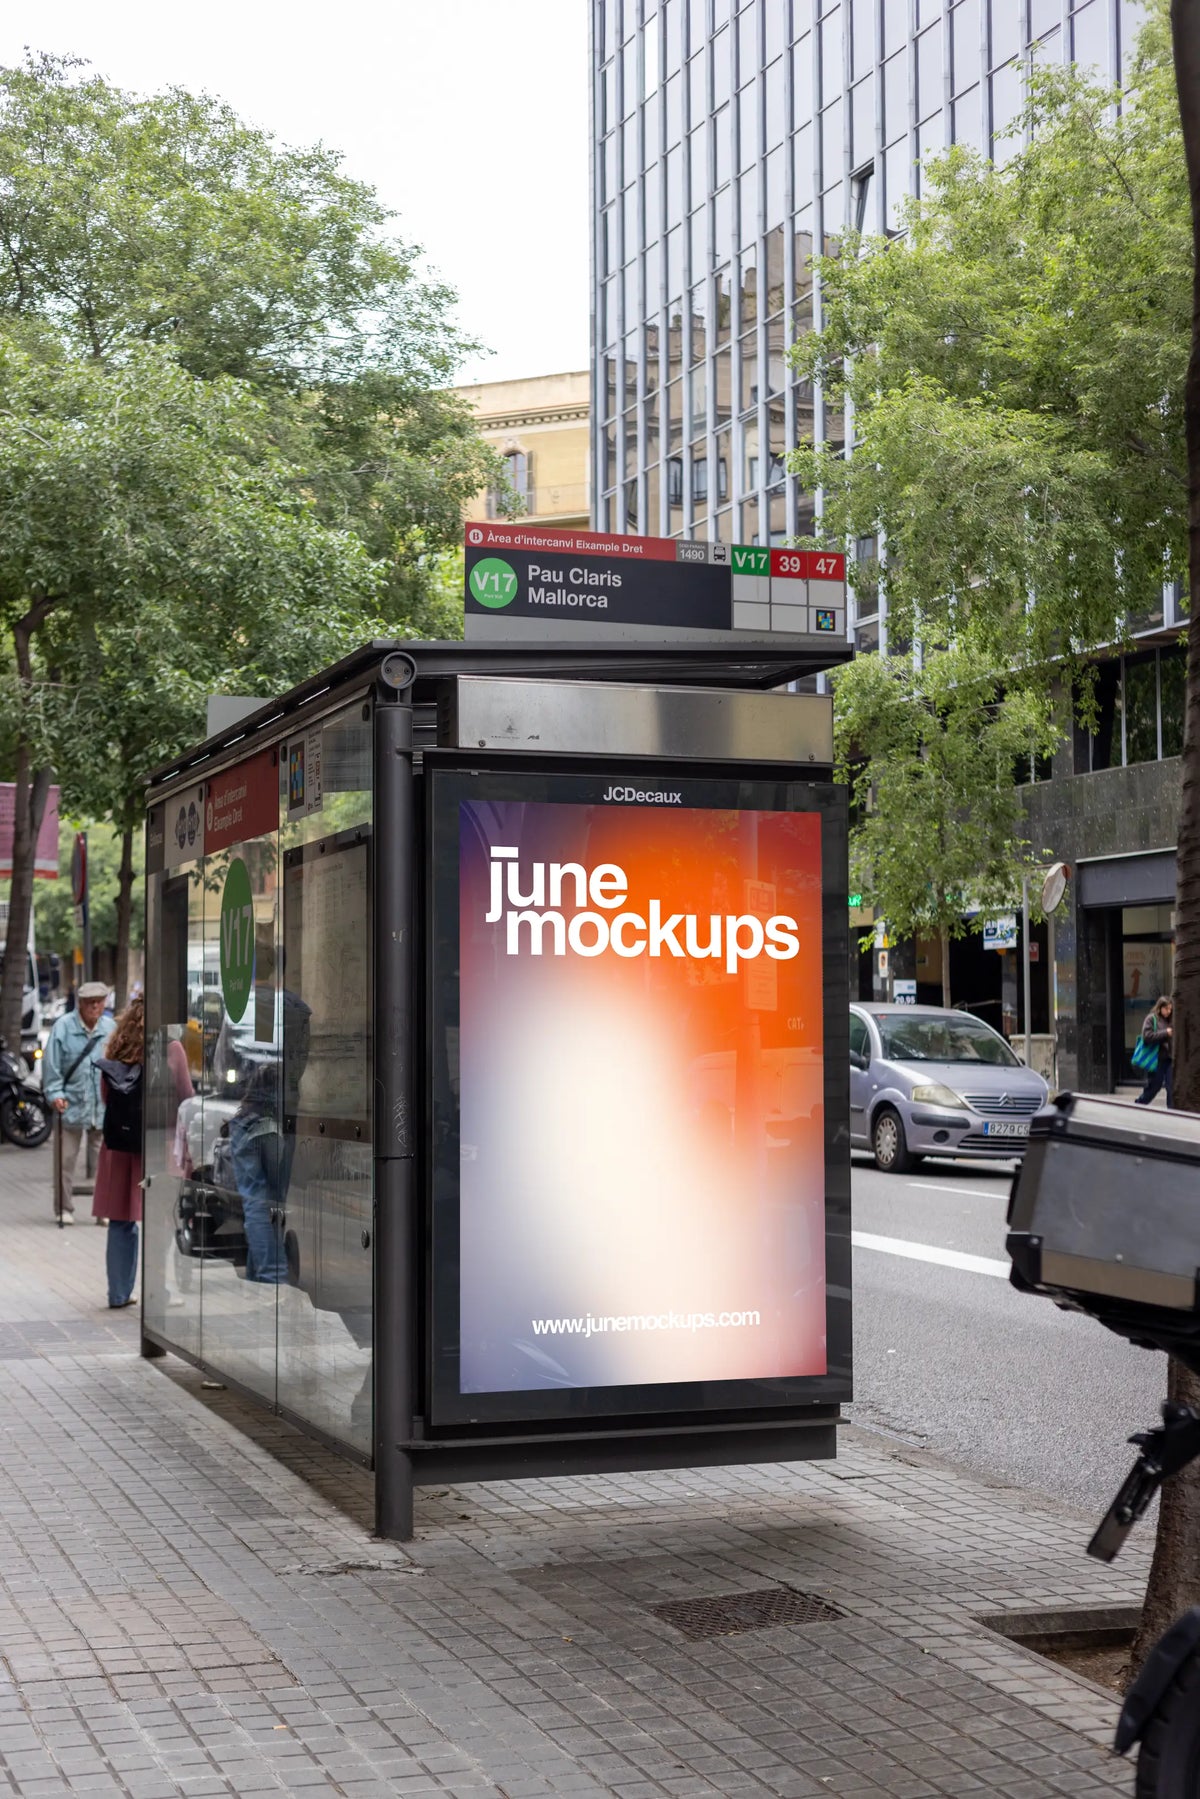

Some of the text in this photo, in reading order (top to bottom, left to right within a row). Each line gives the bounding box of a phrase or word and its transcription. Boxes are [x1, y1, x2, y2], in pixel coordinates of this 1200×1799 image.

[487, 530, 512, 544] Àrea
[576, 539, 620, 553] Eixample
[622, 543, 643, 554] Dret
[680, 549, 705, 561] 1490
[734, 551, 837, 574] V17 39 47
[473, 571, 516, 593] V17
[528, 564, 622, 587] Pau Claris
[528, 586, 609, 608] Mallorca
[603, 786, 682, 804] JCDecaux
[486, 845, 628, 923] june
[222, 904, 252, 969] V17
[506, 899, 800, 974] mockups
[990, 1123, 1029, 1135] 8279 CS
[532, 1310, 760, 1337] www.junemockups.com
